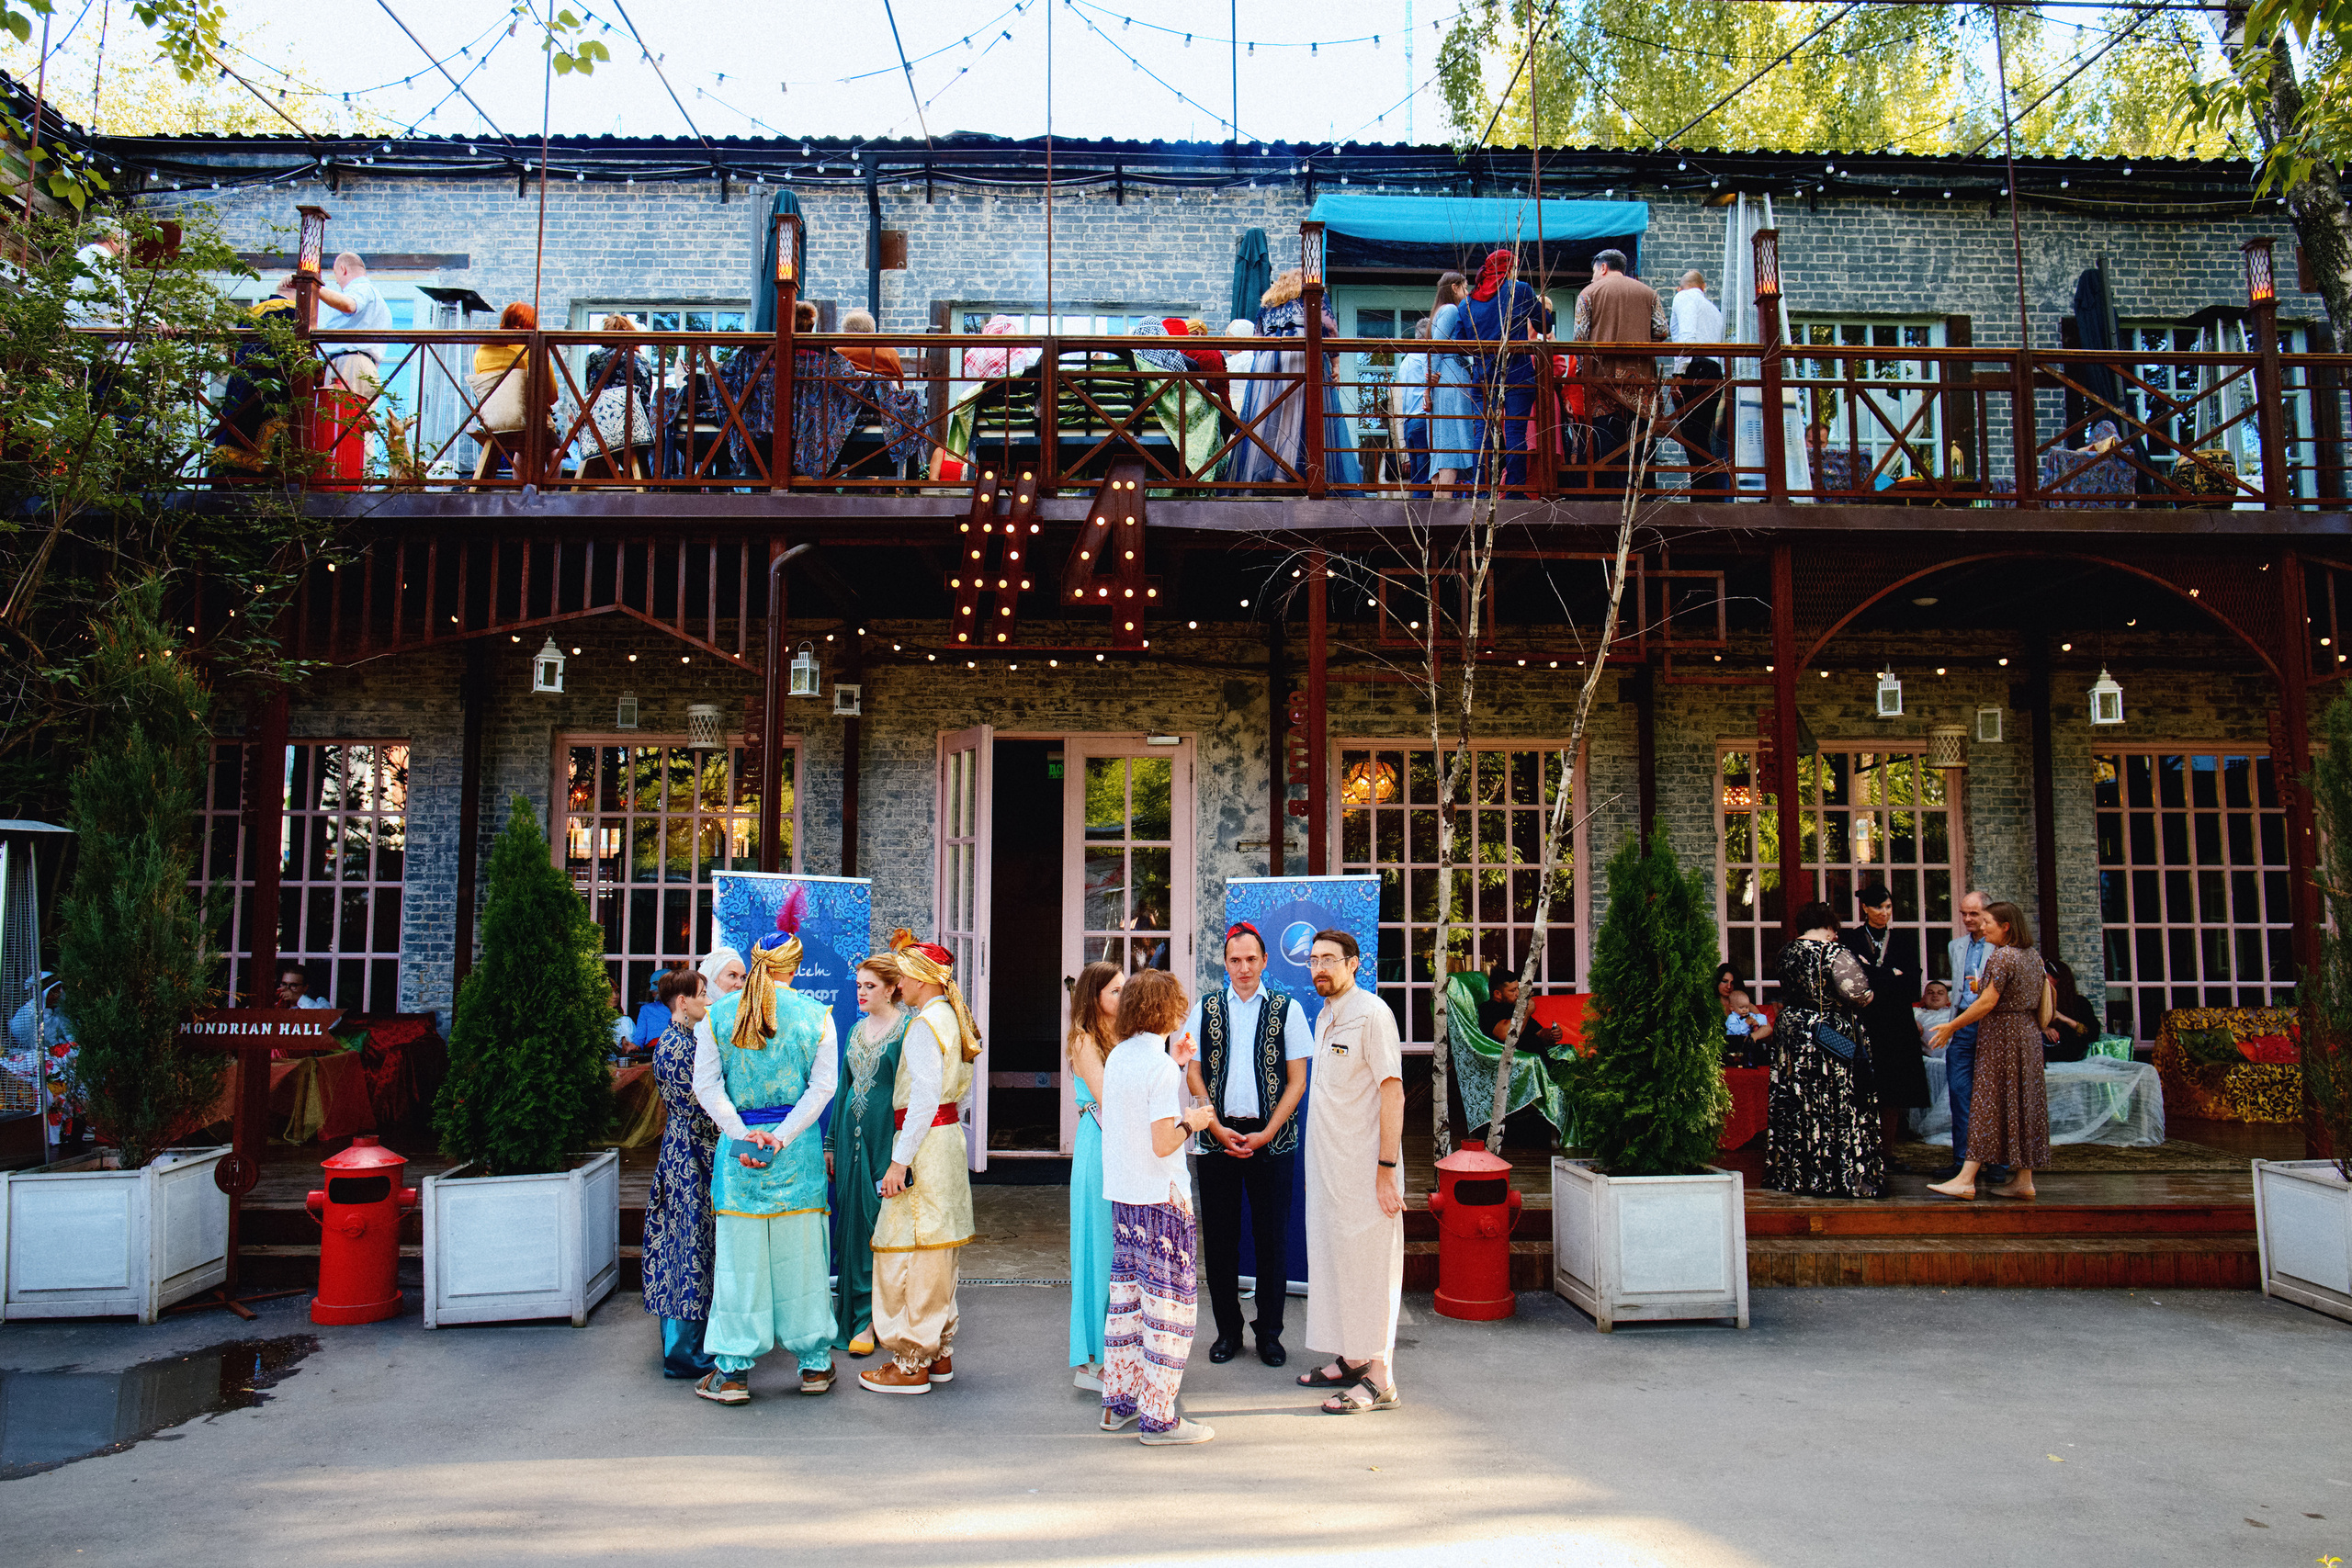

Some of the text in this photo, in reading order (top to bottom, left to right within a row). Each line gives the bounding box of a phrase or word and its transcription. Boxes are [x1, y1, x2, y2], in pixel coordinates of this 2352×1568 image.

[742, 694, 764, 795] MOSCOW
[1288, 691, 1309, 817] SNTIAGO
[179, 1022, 322, 1035] MONDRIAN HALL
